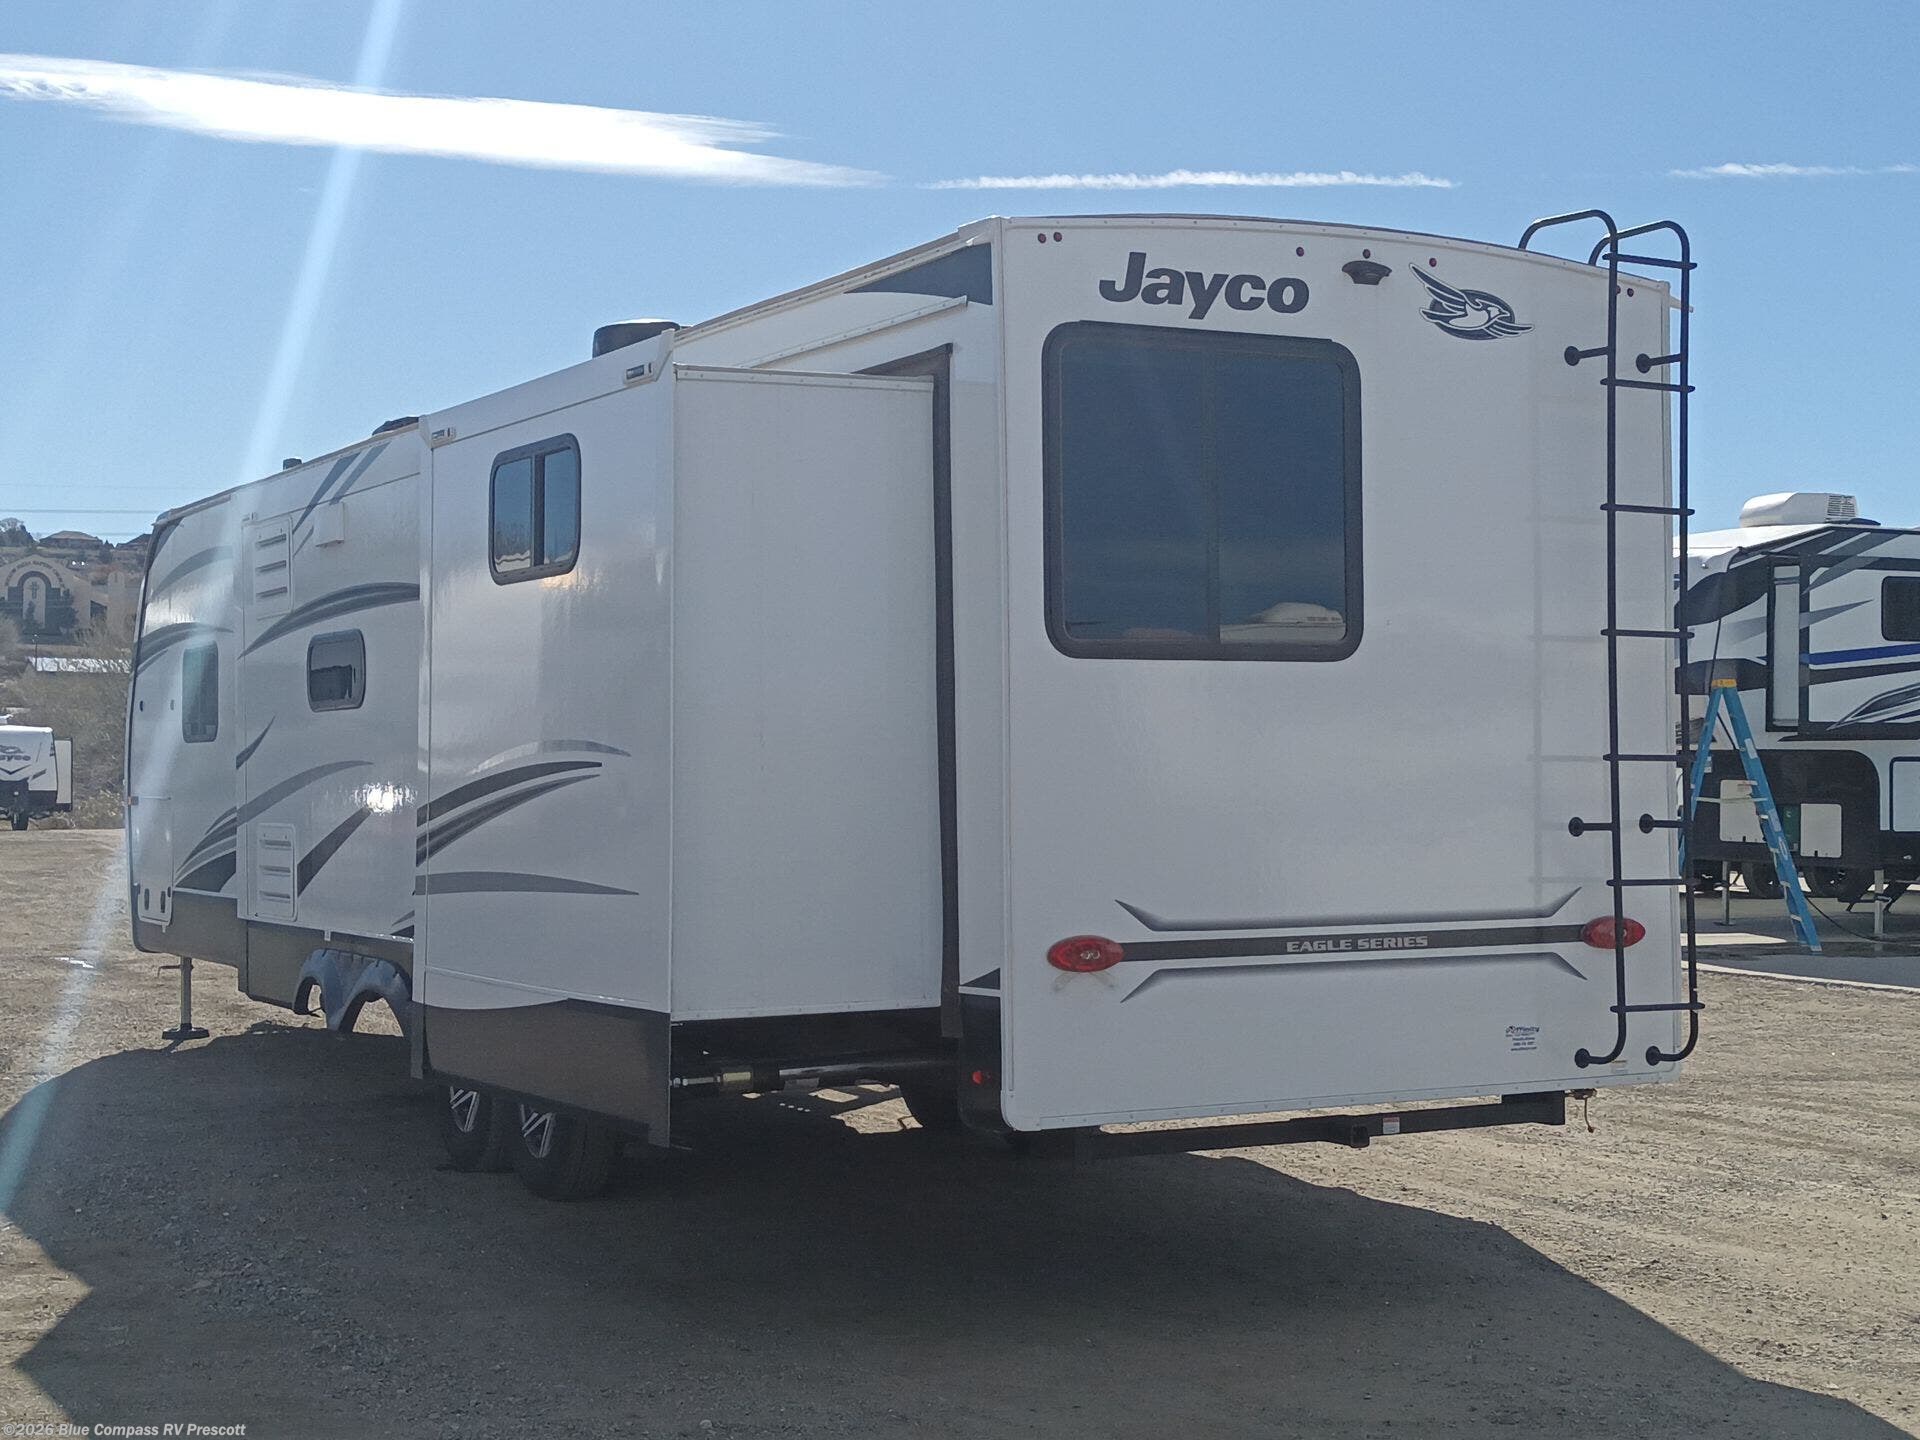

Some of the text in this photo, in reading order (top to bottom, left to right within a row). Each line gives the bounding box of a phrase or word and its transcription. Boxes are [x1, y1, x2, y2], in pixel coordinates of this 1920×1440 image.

[1099, 251, 1310, 320] Jayco
[1286, 936, 1428, 953] EAGLE SERIES
